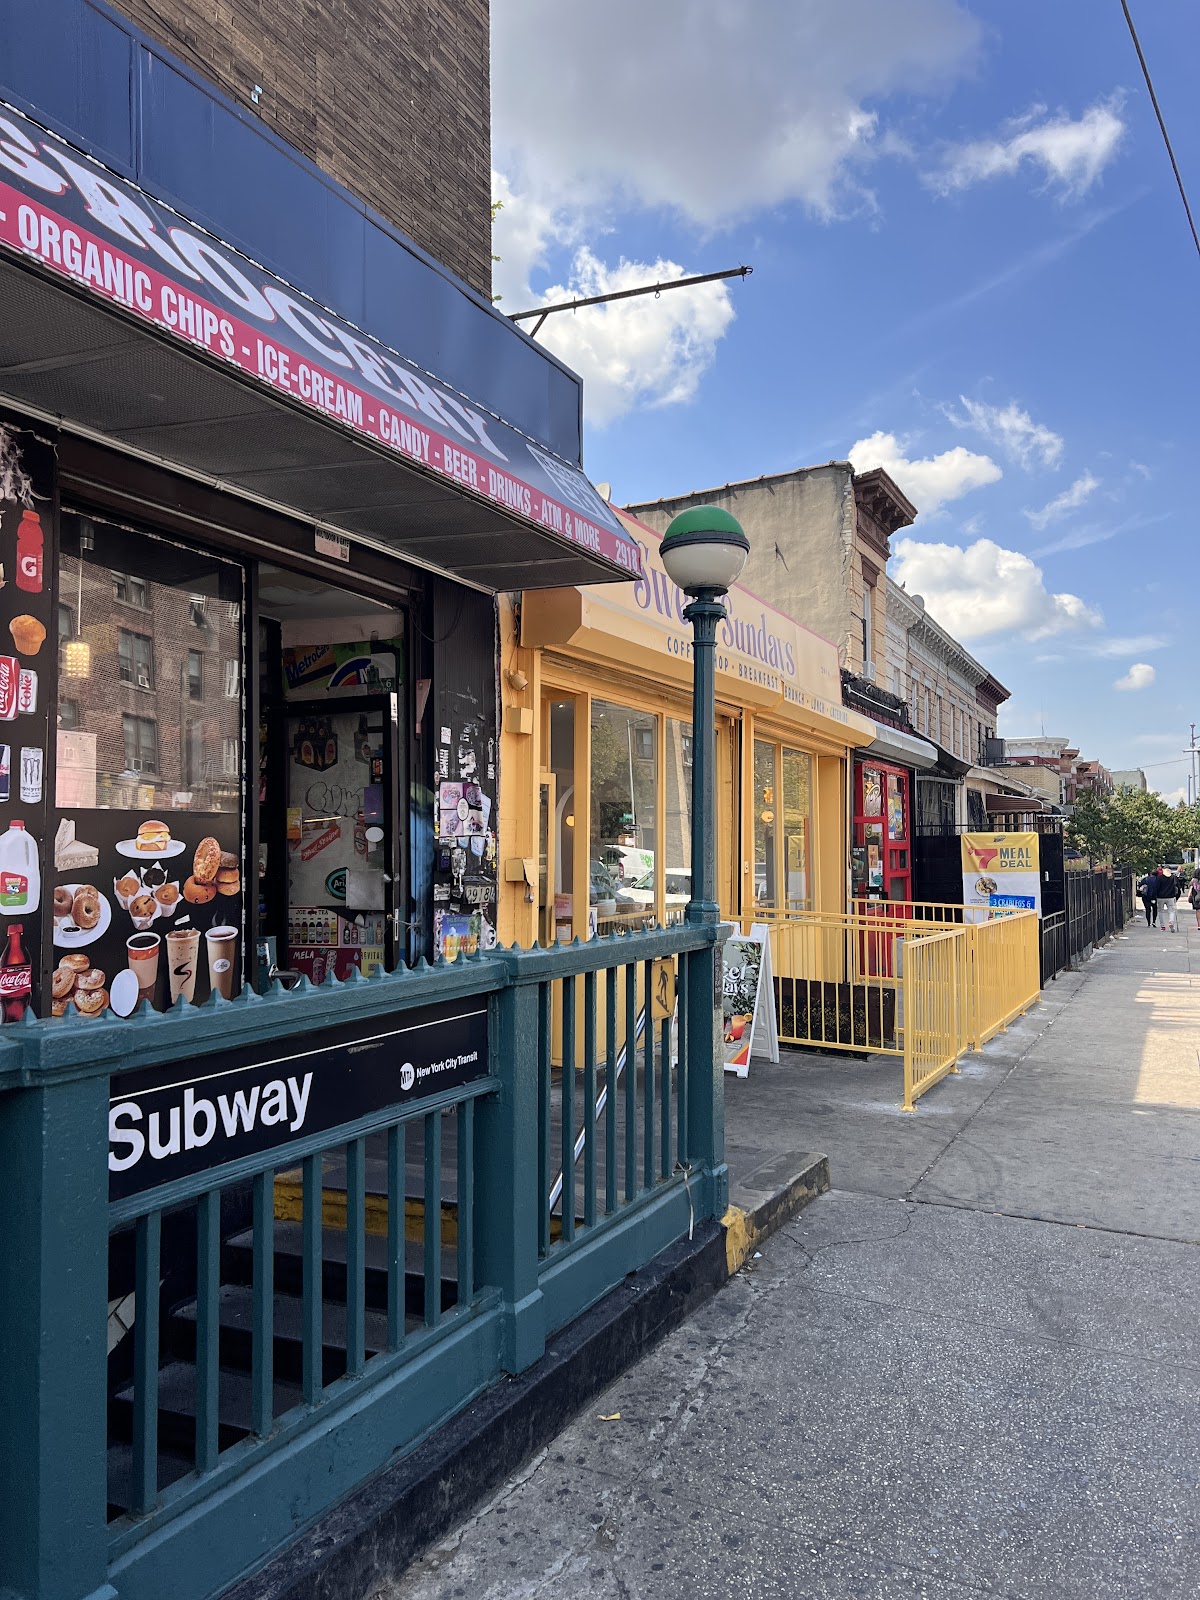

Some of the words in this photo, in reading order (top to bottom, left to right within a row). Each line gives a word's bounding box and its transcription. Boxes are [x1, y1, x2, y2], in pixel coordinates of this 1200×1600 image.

[18, 204, 152, 312] ORGANIC
[161, 286, 235, 356] CHIPS
[257, 338, 363, 426] ICE-CREAM
[380, 408, 430, 462] CANDY
[444, 444, 478, 486] BEER
[489, 468, 531, 514] DRINKS
[541, 498, 563, 531] ATM
[564, 512, 572, 538] &
[574, 517, 600, 551] MORE
[615, 539, 638, 571] 2918
[21, 556, 37, 577] G
[634, 541, 690, 626] Swe
[721, 595, 796, 679] Sundays
[386, 679, 391, 688] 6
[667, 636, 694, 660] COFF
[738, 663, 779, 689] BREAKFAST
[785, 685, 805, 705] BRUNCH
[20, 675, 32, 709] Coke
[1000, 847, 1031, 860] MEAL
[1000, 860, 1032, 868] DEAL
[293, 950, 315, 960] MELA
[416, 1067, 431, 1079] New
[430, 1061, 445, 1074] York
[445, 1058, 457, 1070] City
[457, 1050, 478, 1066] Transit
[108, 1071, 313, 1172] Subway
